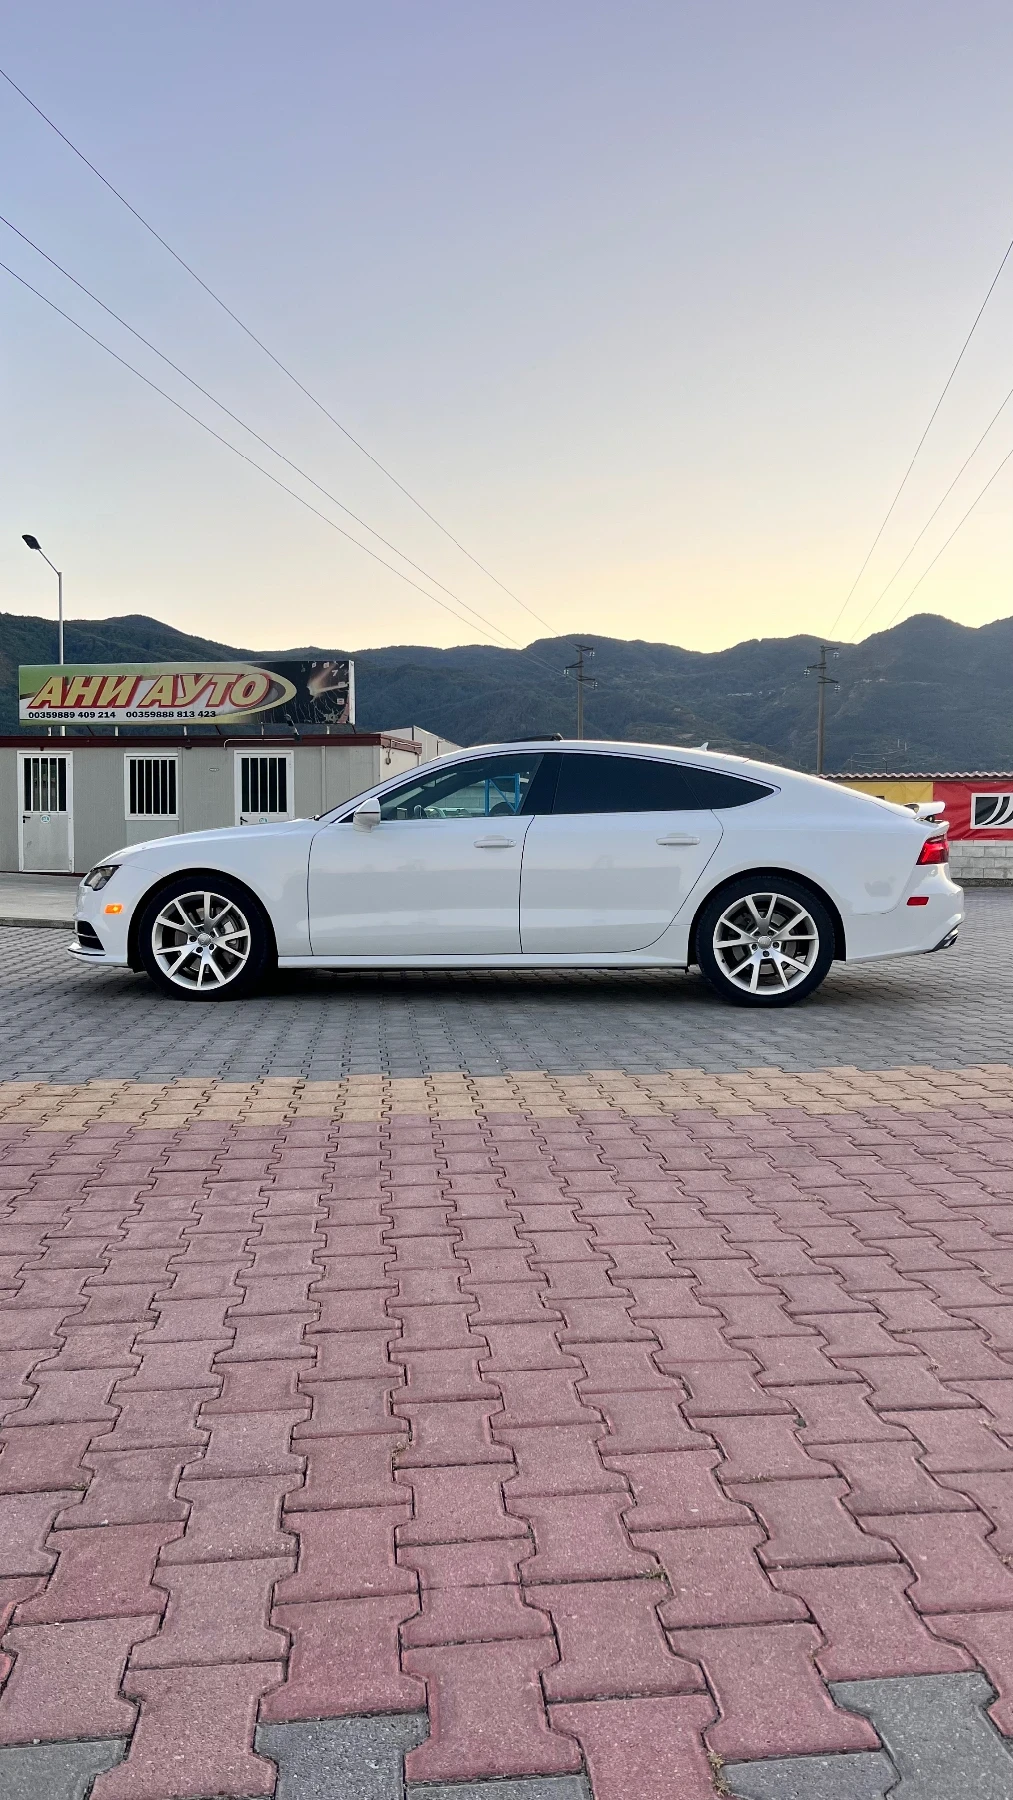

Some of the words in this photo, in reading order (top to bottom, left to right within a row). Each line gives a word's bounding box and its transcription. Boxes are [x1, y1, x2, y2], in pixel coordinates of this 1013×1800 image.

[27, 675, 142, 708] АНИ
[136, 673, 271, 708] АУТО
[28, 711, 75, 719] 00359889
[176, 710, 195, 718] 813
[197, 710, 216, 718] 423
